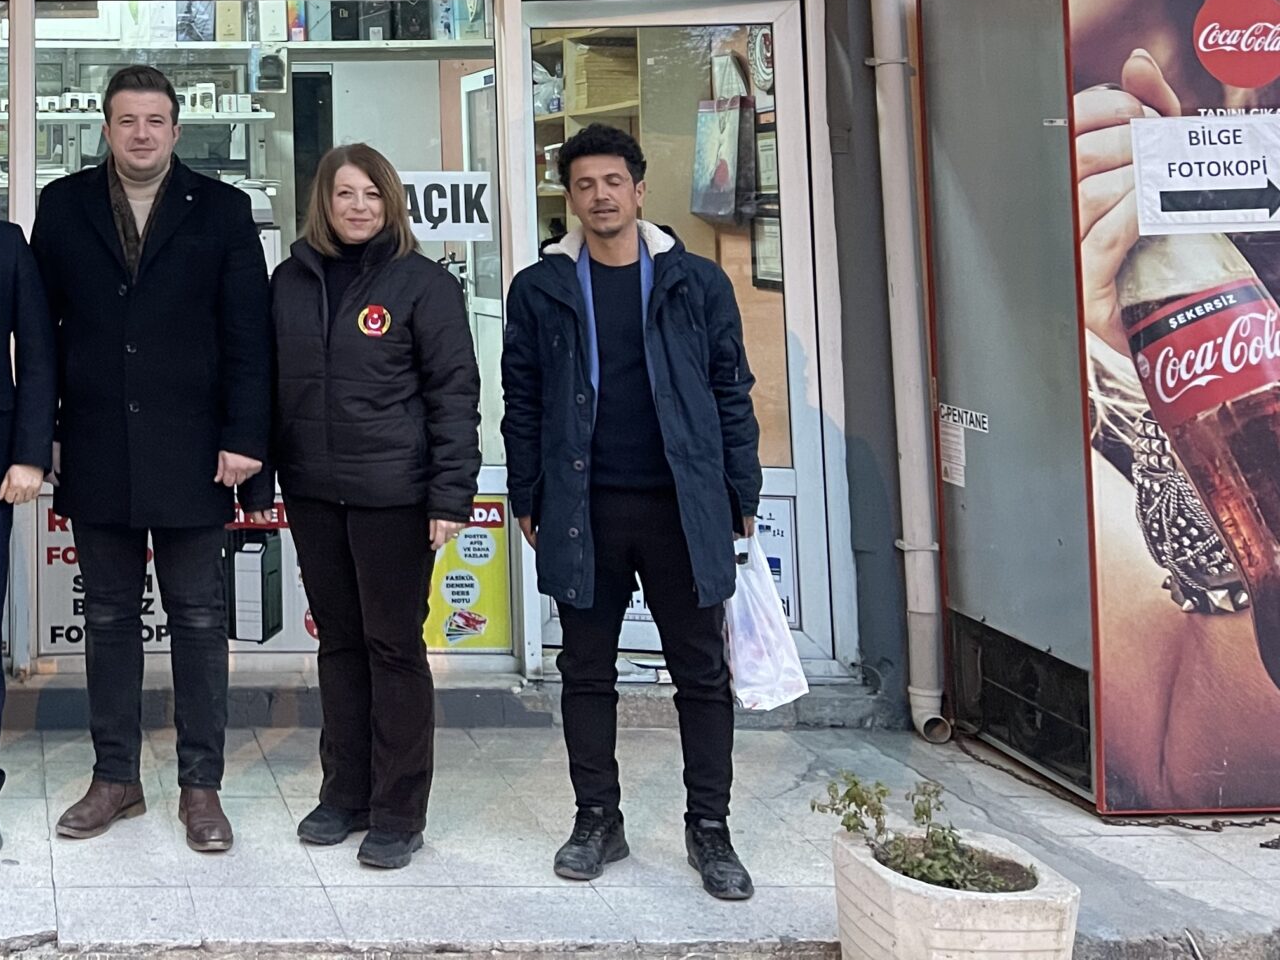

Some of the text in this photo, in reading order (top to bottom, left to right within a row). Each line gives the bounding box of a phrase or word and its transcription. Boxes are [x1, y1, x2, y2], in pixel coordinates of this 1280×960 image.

[1189, 126, 1243, 146] BİLGE
[1168, 155, 1268, 178] FOTOKOPİ
[404, 183, 489, 229] AÇIK
[1168, 294, 1238, 329] ŞEKERSİZ
[940, 404, 988, 431] C-PENTANE
